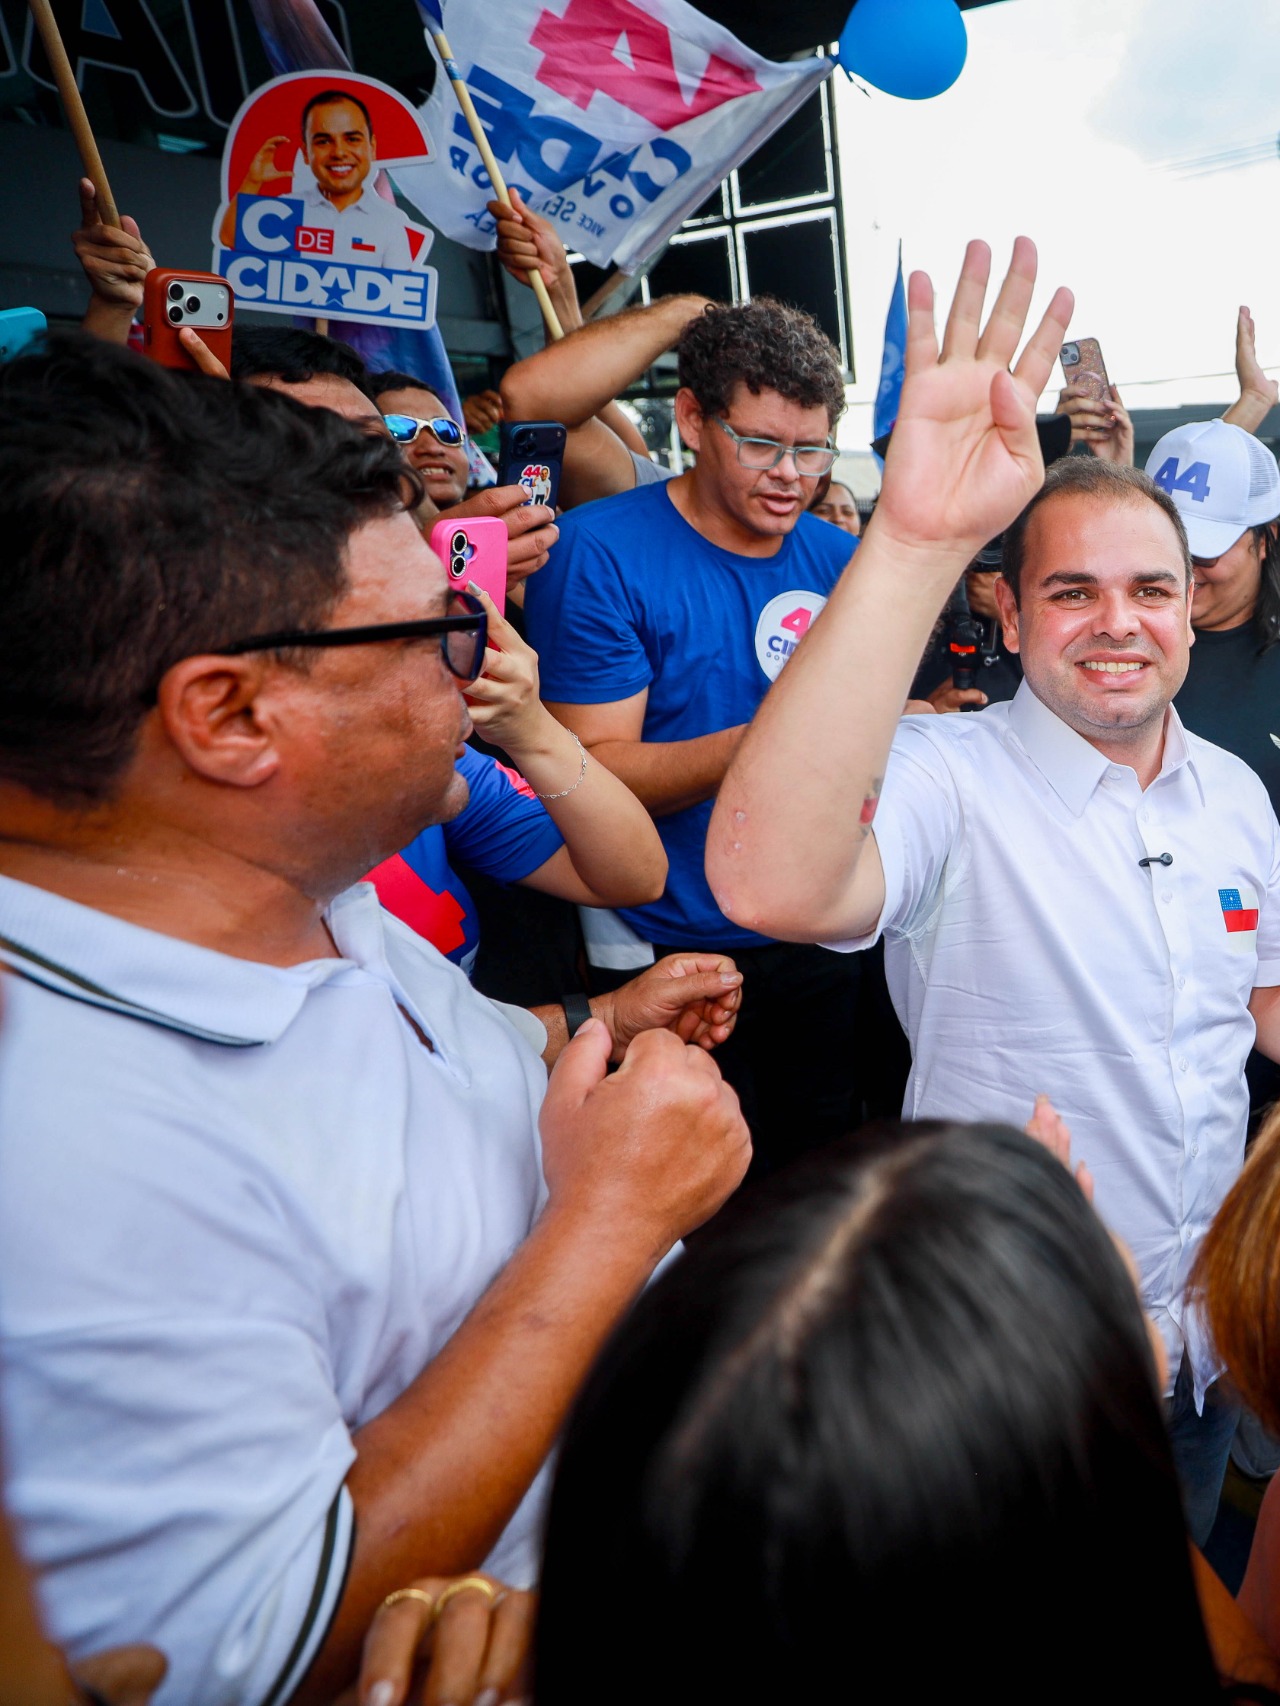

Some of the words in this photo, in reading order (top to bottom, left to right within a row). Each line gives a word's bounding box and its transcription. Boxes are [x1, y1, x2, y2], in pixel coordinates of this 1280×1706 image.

[242, 200, 293, 252] C
[298, 231, 331, 250] DE
[226, 256, 424, 317] CIDADE
[523, 466, 541, 477] 44
[1154, 457, 1210, 502] 44
